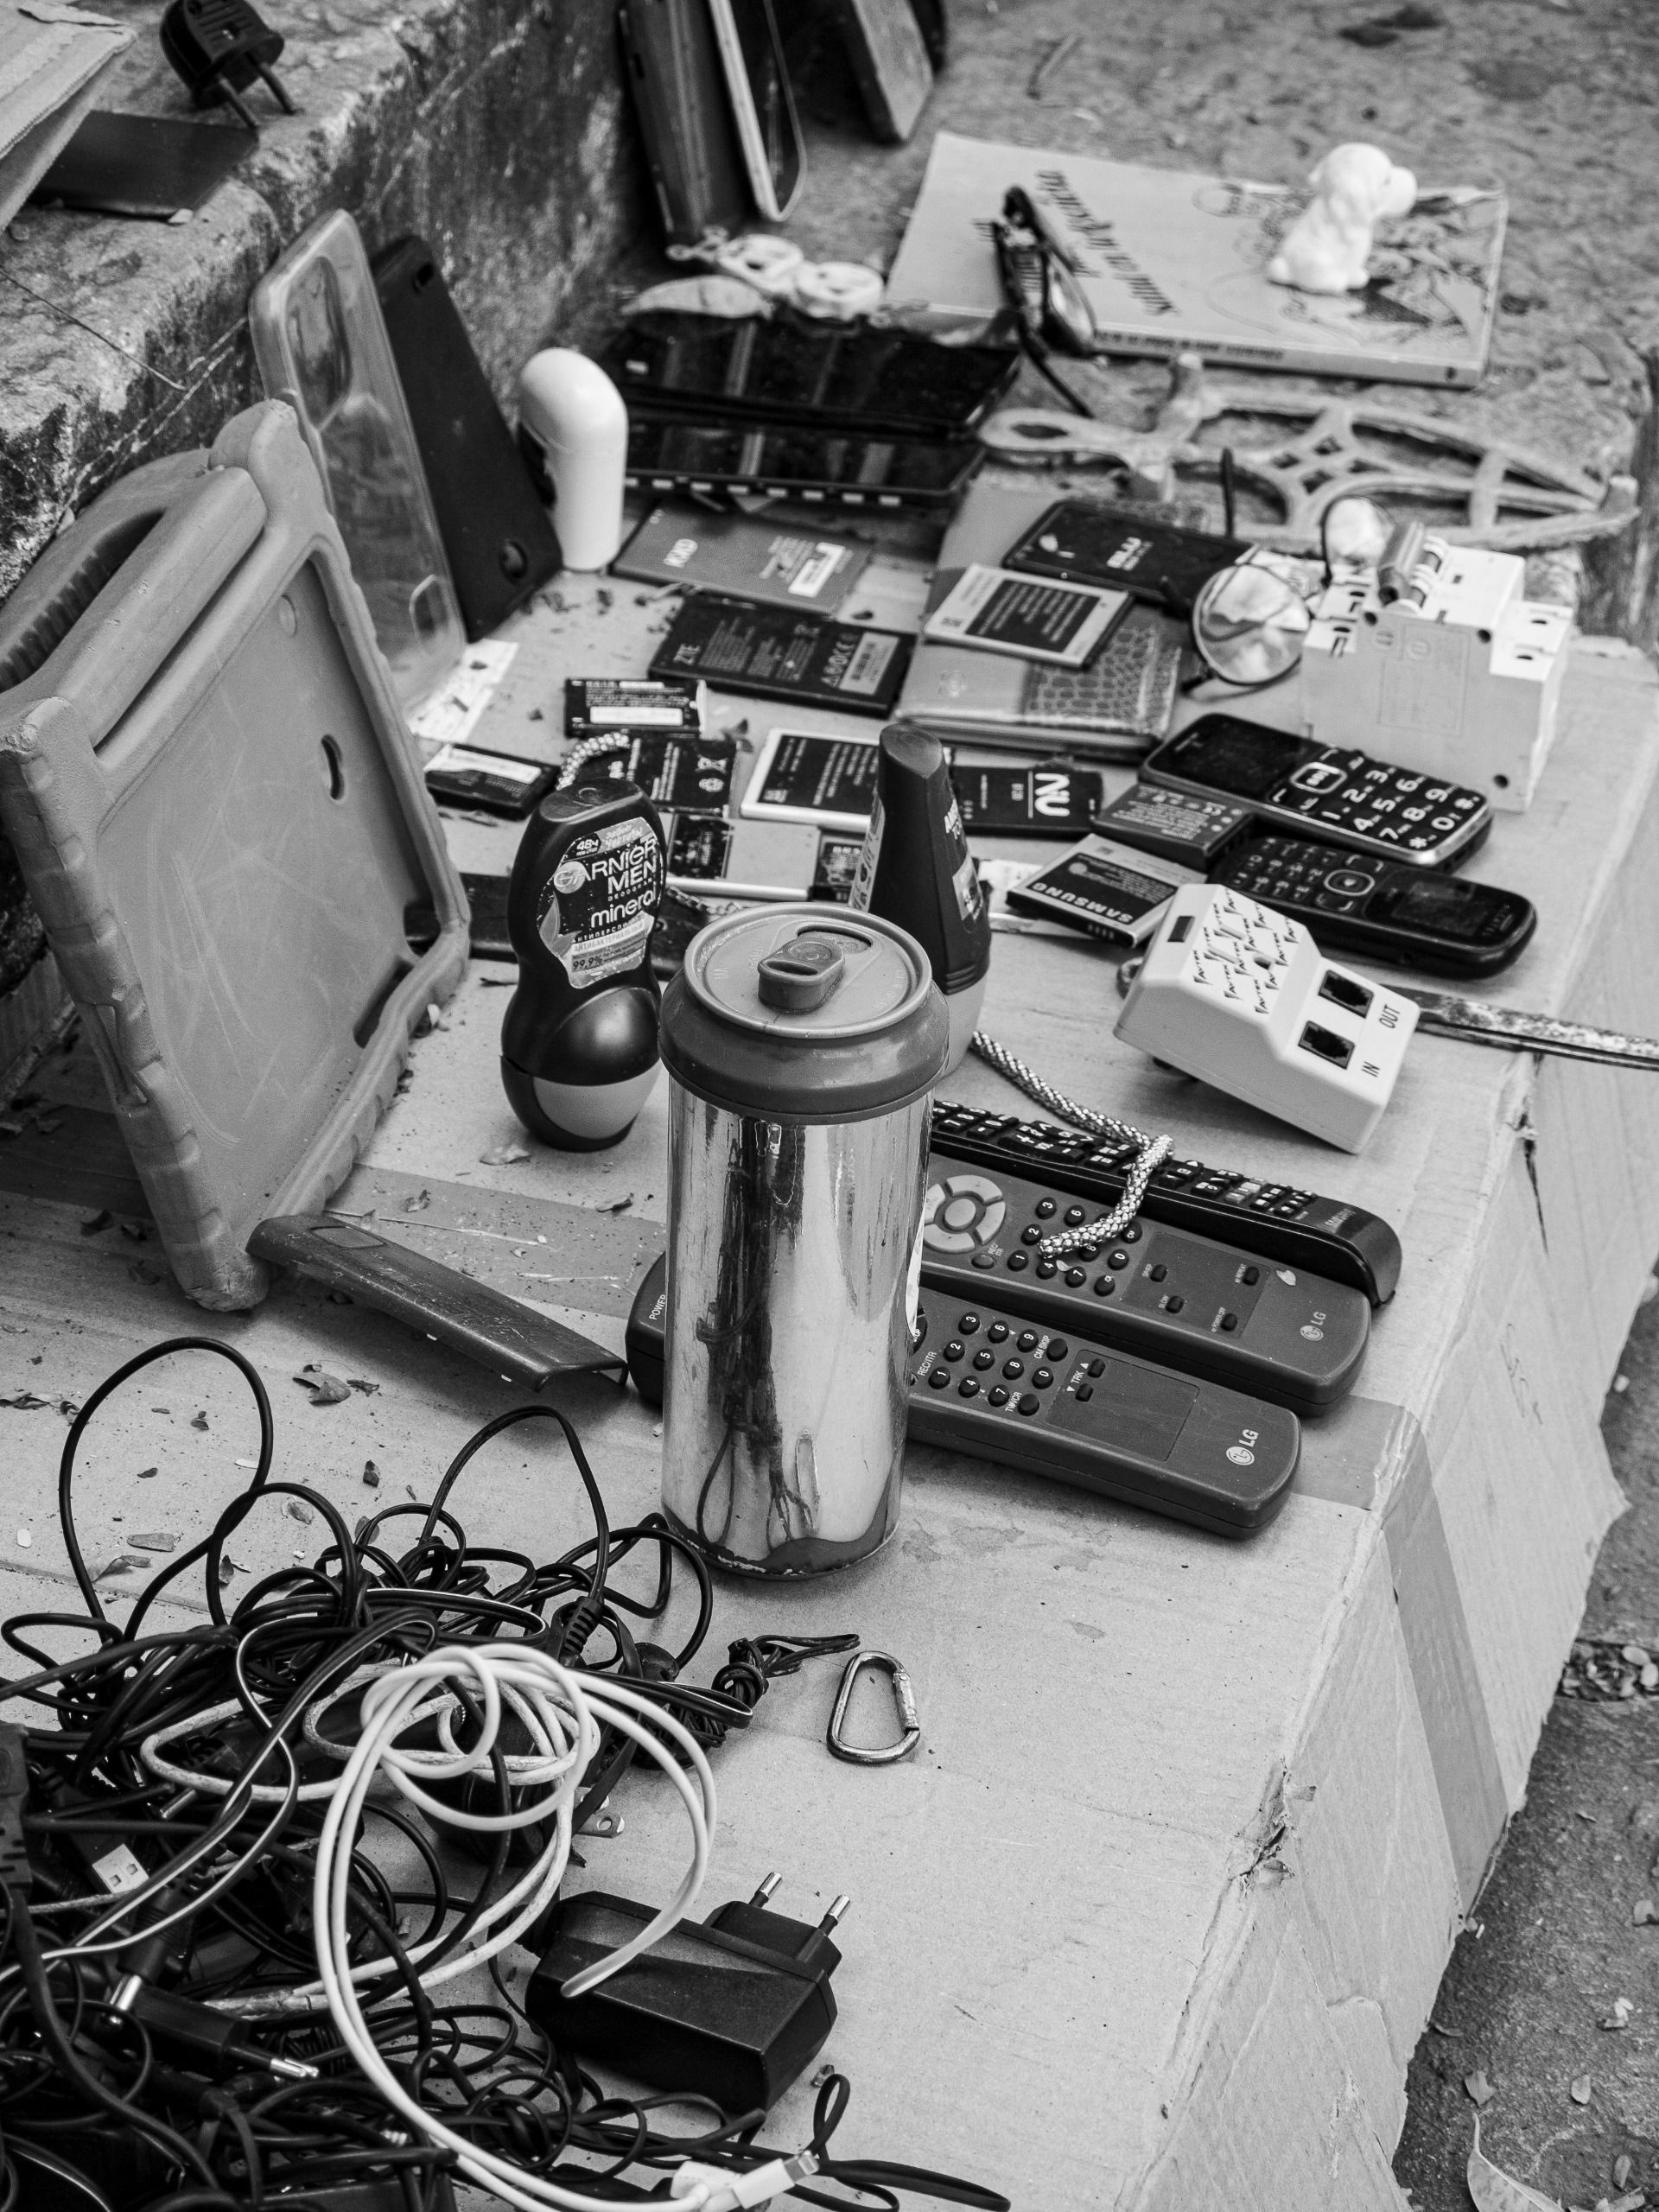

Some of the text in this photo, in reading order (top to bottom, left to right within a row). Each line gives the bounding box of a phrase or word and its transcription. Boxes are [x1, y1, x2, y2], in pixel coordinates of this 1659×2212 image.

[1365, 770, 1389, 784] 3
[1395, 779, 1419, 792] 6
[1342, 789, 1367, 803] 2
[1425, 788, 1448, 803] 9
[1371, 798, 1396, 812] 5
[1402, 807, 1426, 822] 8
[1353, 817, 1375, 831] 4
[1379, 827, 1399, 840] 7
[607, 858, 657, 894] MEN
[591, 882, 656, 928] mineral
[1032, 882, 1134, 922] SAMSUNG
[1379, 1004, 1401, 1028] OUT
[1362, 1061, 1380, 1077] IN
[1311, 1311, 1326, 1325] LG
[1034, 1335, 1050, 1359] CM SKIP
[1071, 1371, 1084, 1384] TRK
[1238, 1429, 1259, 1447] LG
